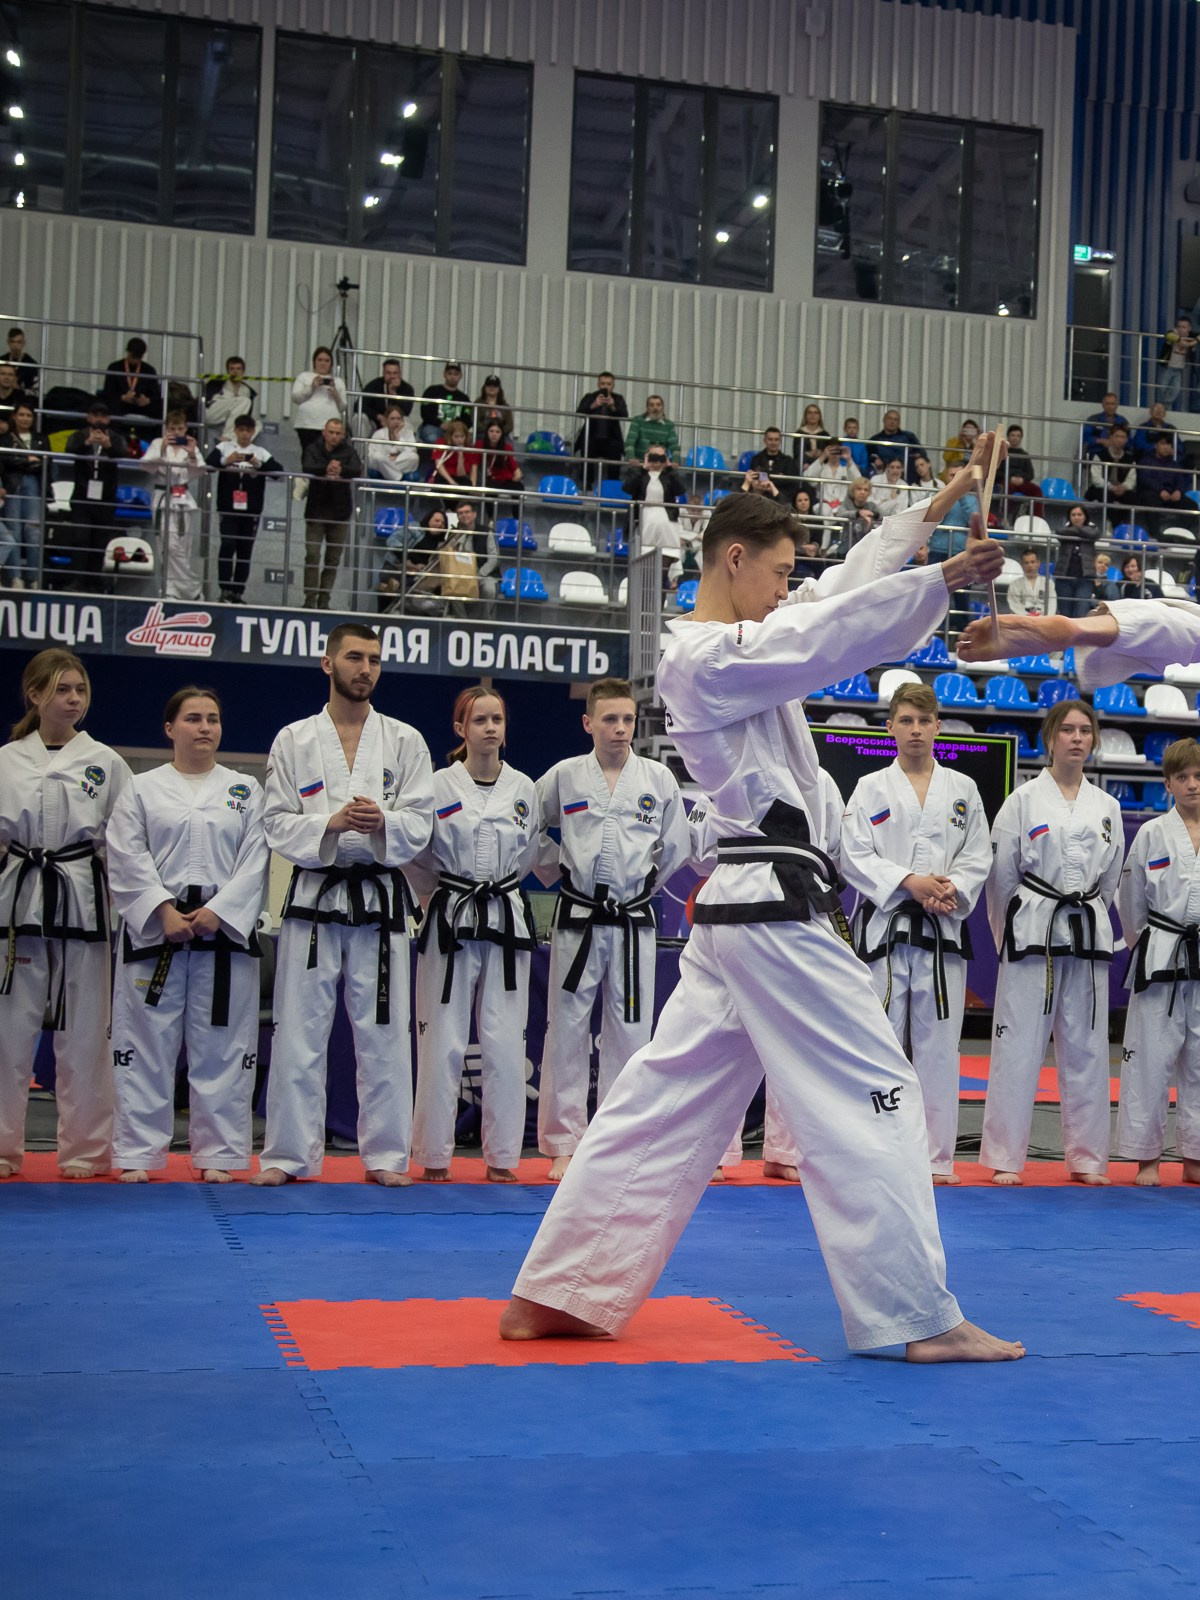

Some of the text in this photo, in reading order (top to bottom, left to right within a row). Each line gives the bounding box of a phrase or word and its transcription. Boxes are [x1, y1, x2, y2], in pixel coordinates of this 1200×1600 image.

[236, 616, 610, 675] ТУЛЬАЯ ОБЛАСТЬ
[826, 734, 988, 752] Всероссийс едерация
